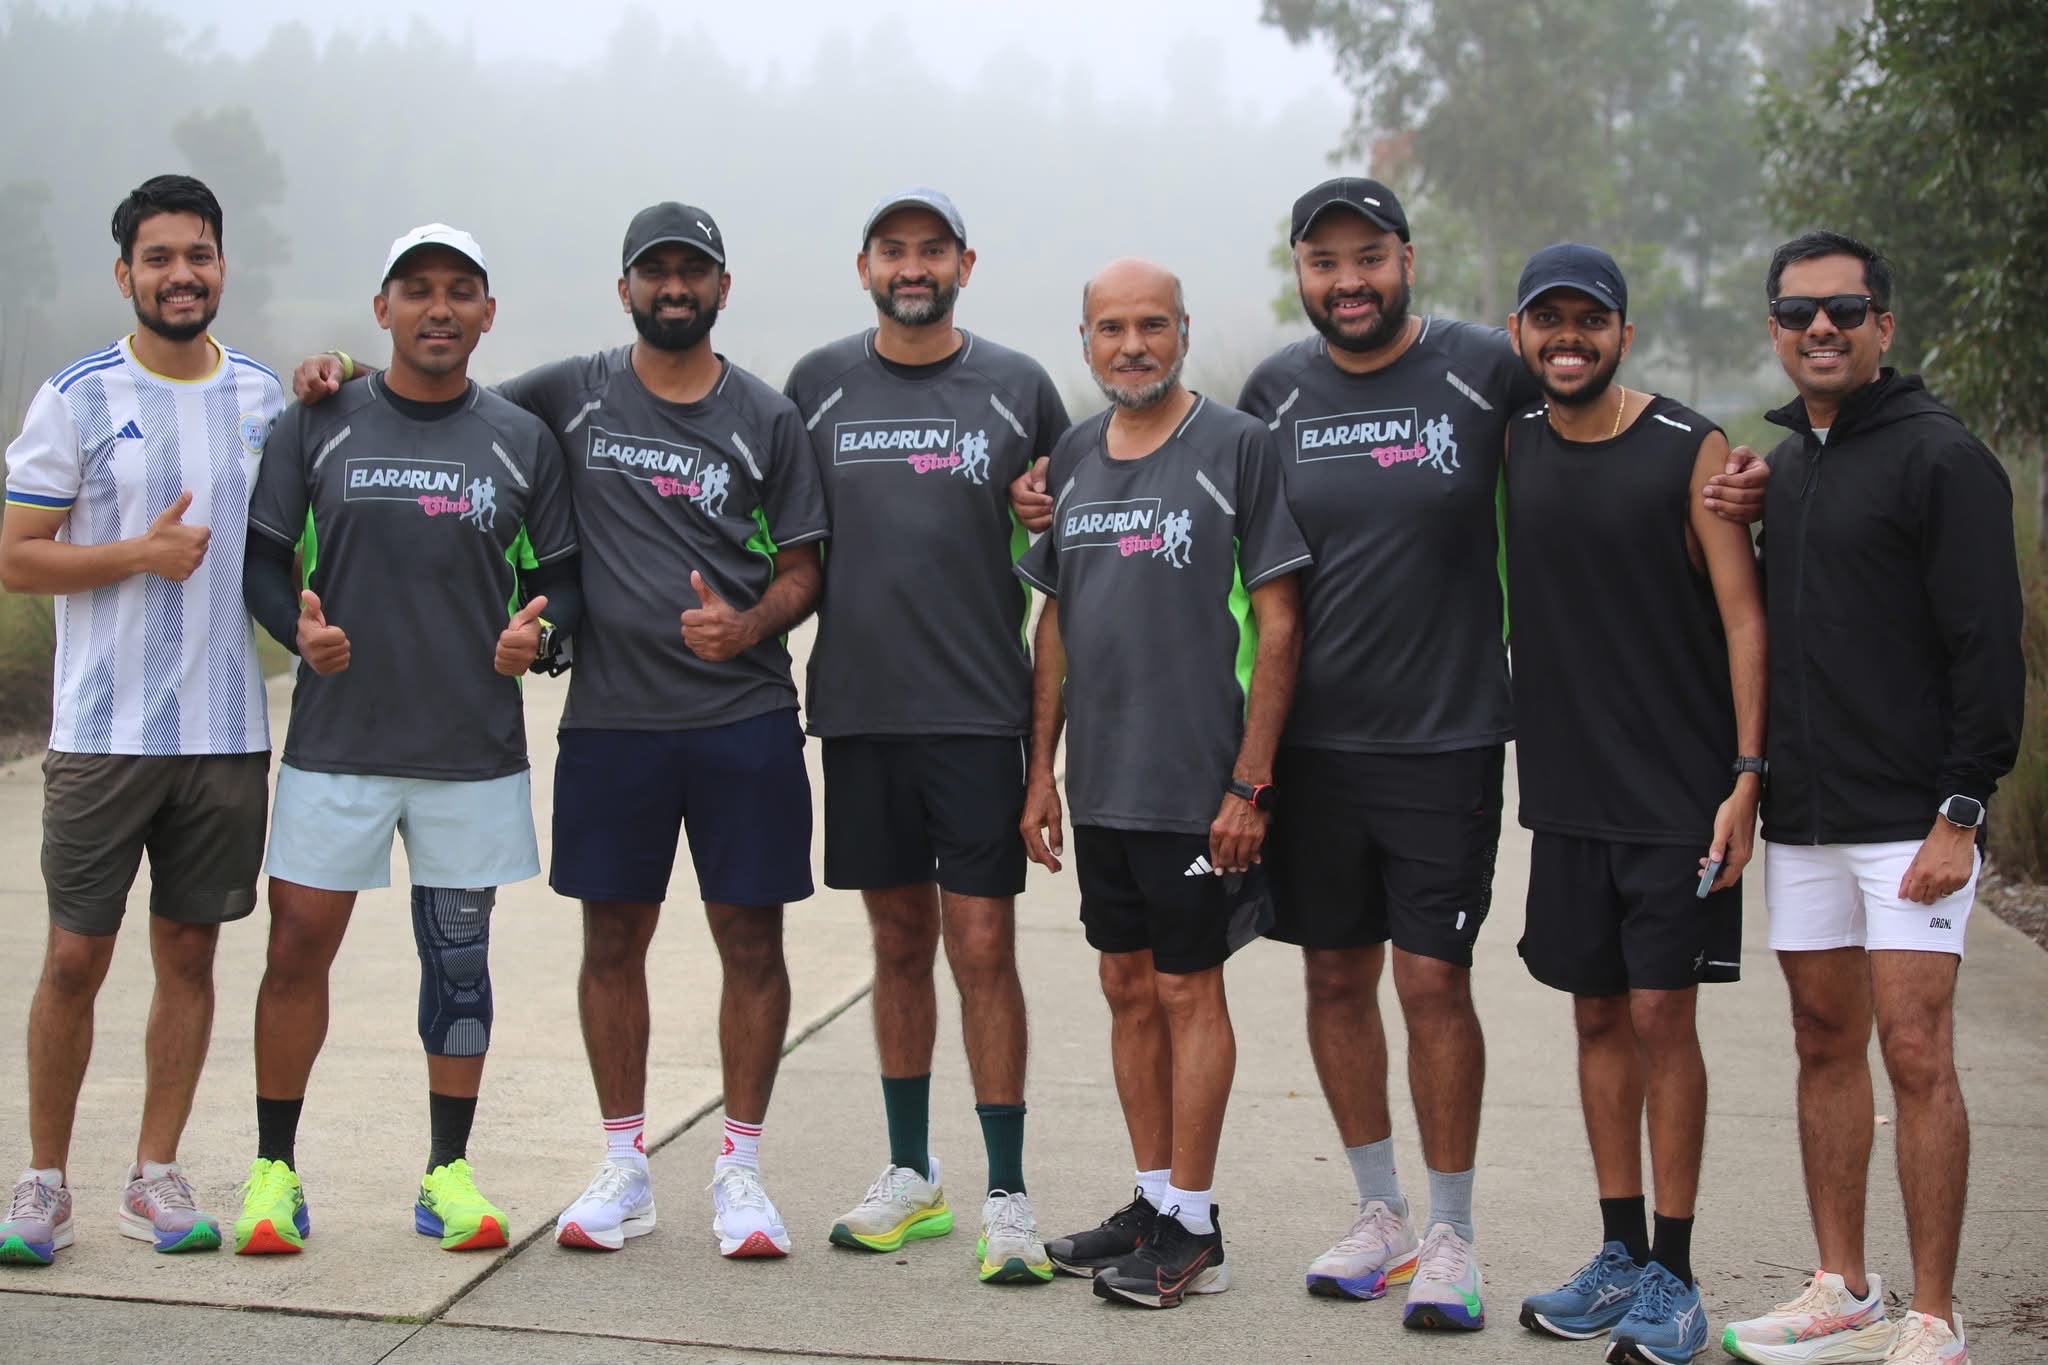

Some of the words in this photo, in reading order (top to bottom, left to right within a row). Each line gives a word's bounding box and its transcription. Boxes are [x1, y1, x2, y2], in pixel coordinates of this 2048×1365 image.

[907, 450, 961, 474] Club
[1371, 441, 1426, 467] Club
[652, 475, 701, 497] Club
[417, 495, 471, 516] Club
[1118, 532, 1163, 557] Club
